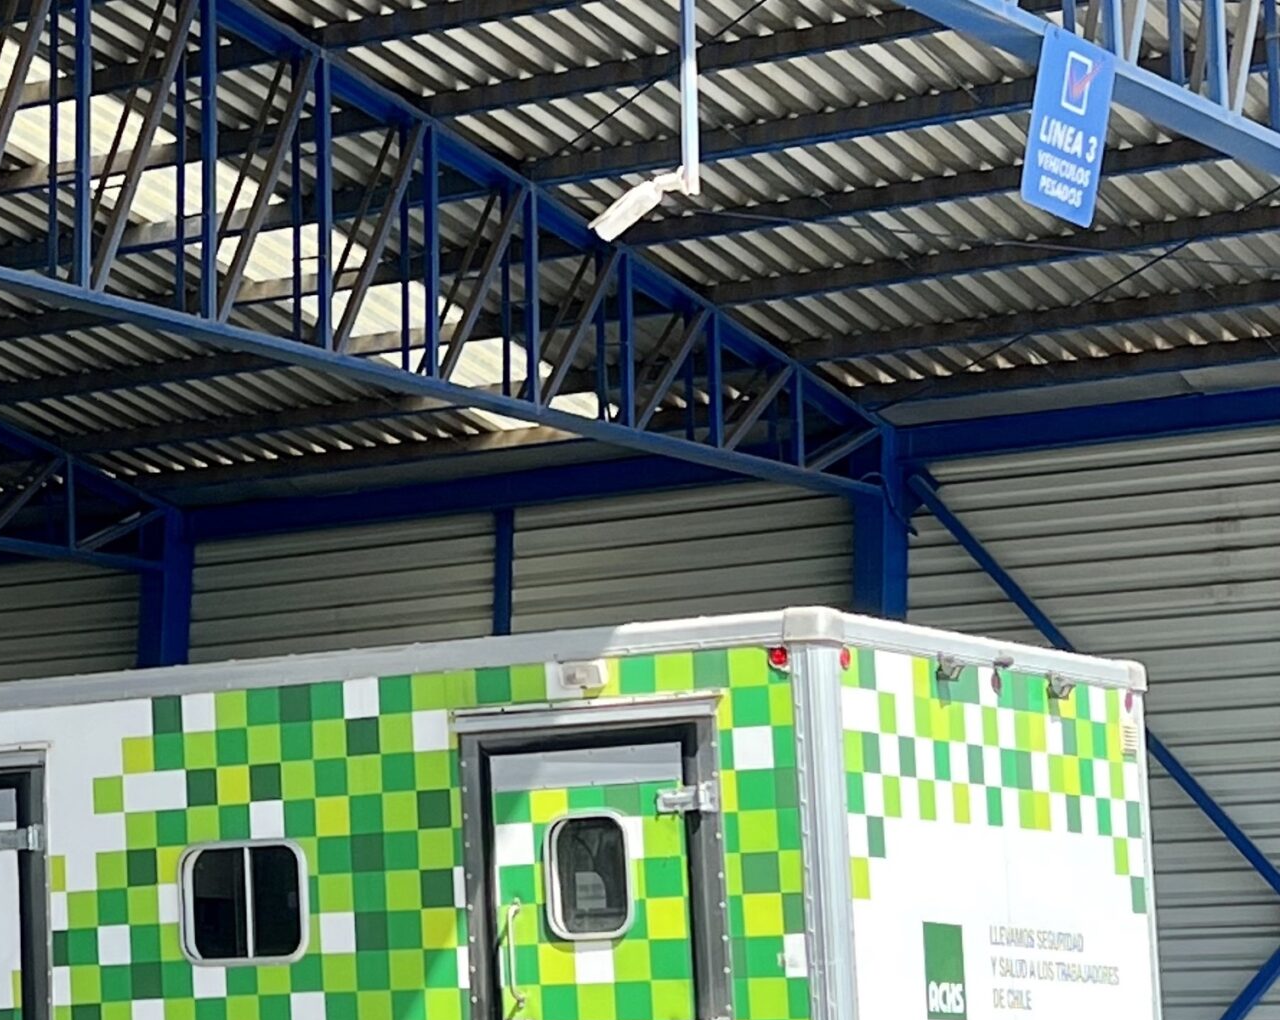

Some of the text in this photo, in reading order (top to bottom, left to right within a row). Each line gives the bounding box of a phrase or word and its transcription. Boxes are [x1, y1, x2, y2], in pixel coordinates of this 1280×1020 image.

[1039, 115, 1098, 163] LINEA 3
[1037, 150, 1091, 188] VEHICULOS
[1038, 174, 1083, 209] PESADOS
[989, 924, 1084, 953] LLEVAMOS SEGURIDAD
[990, 956, 1120, 986] Y SALUD A LOS TRABAJADORES
[928, 979, 965, 1014] ACHS
[992, 988, 1032, 1010] DE CHILE
